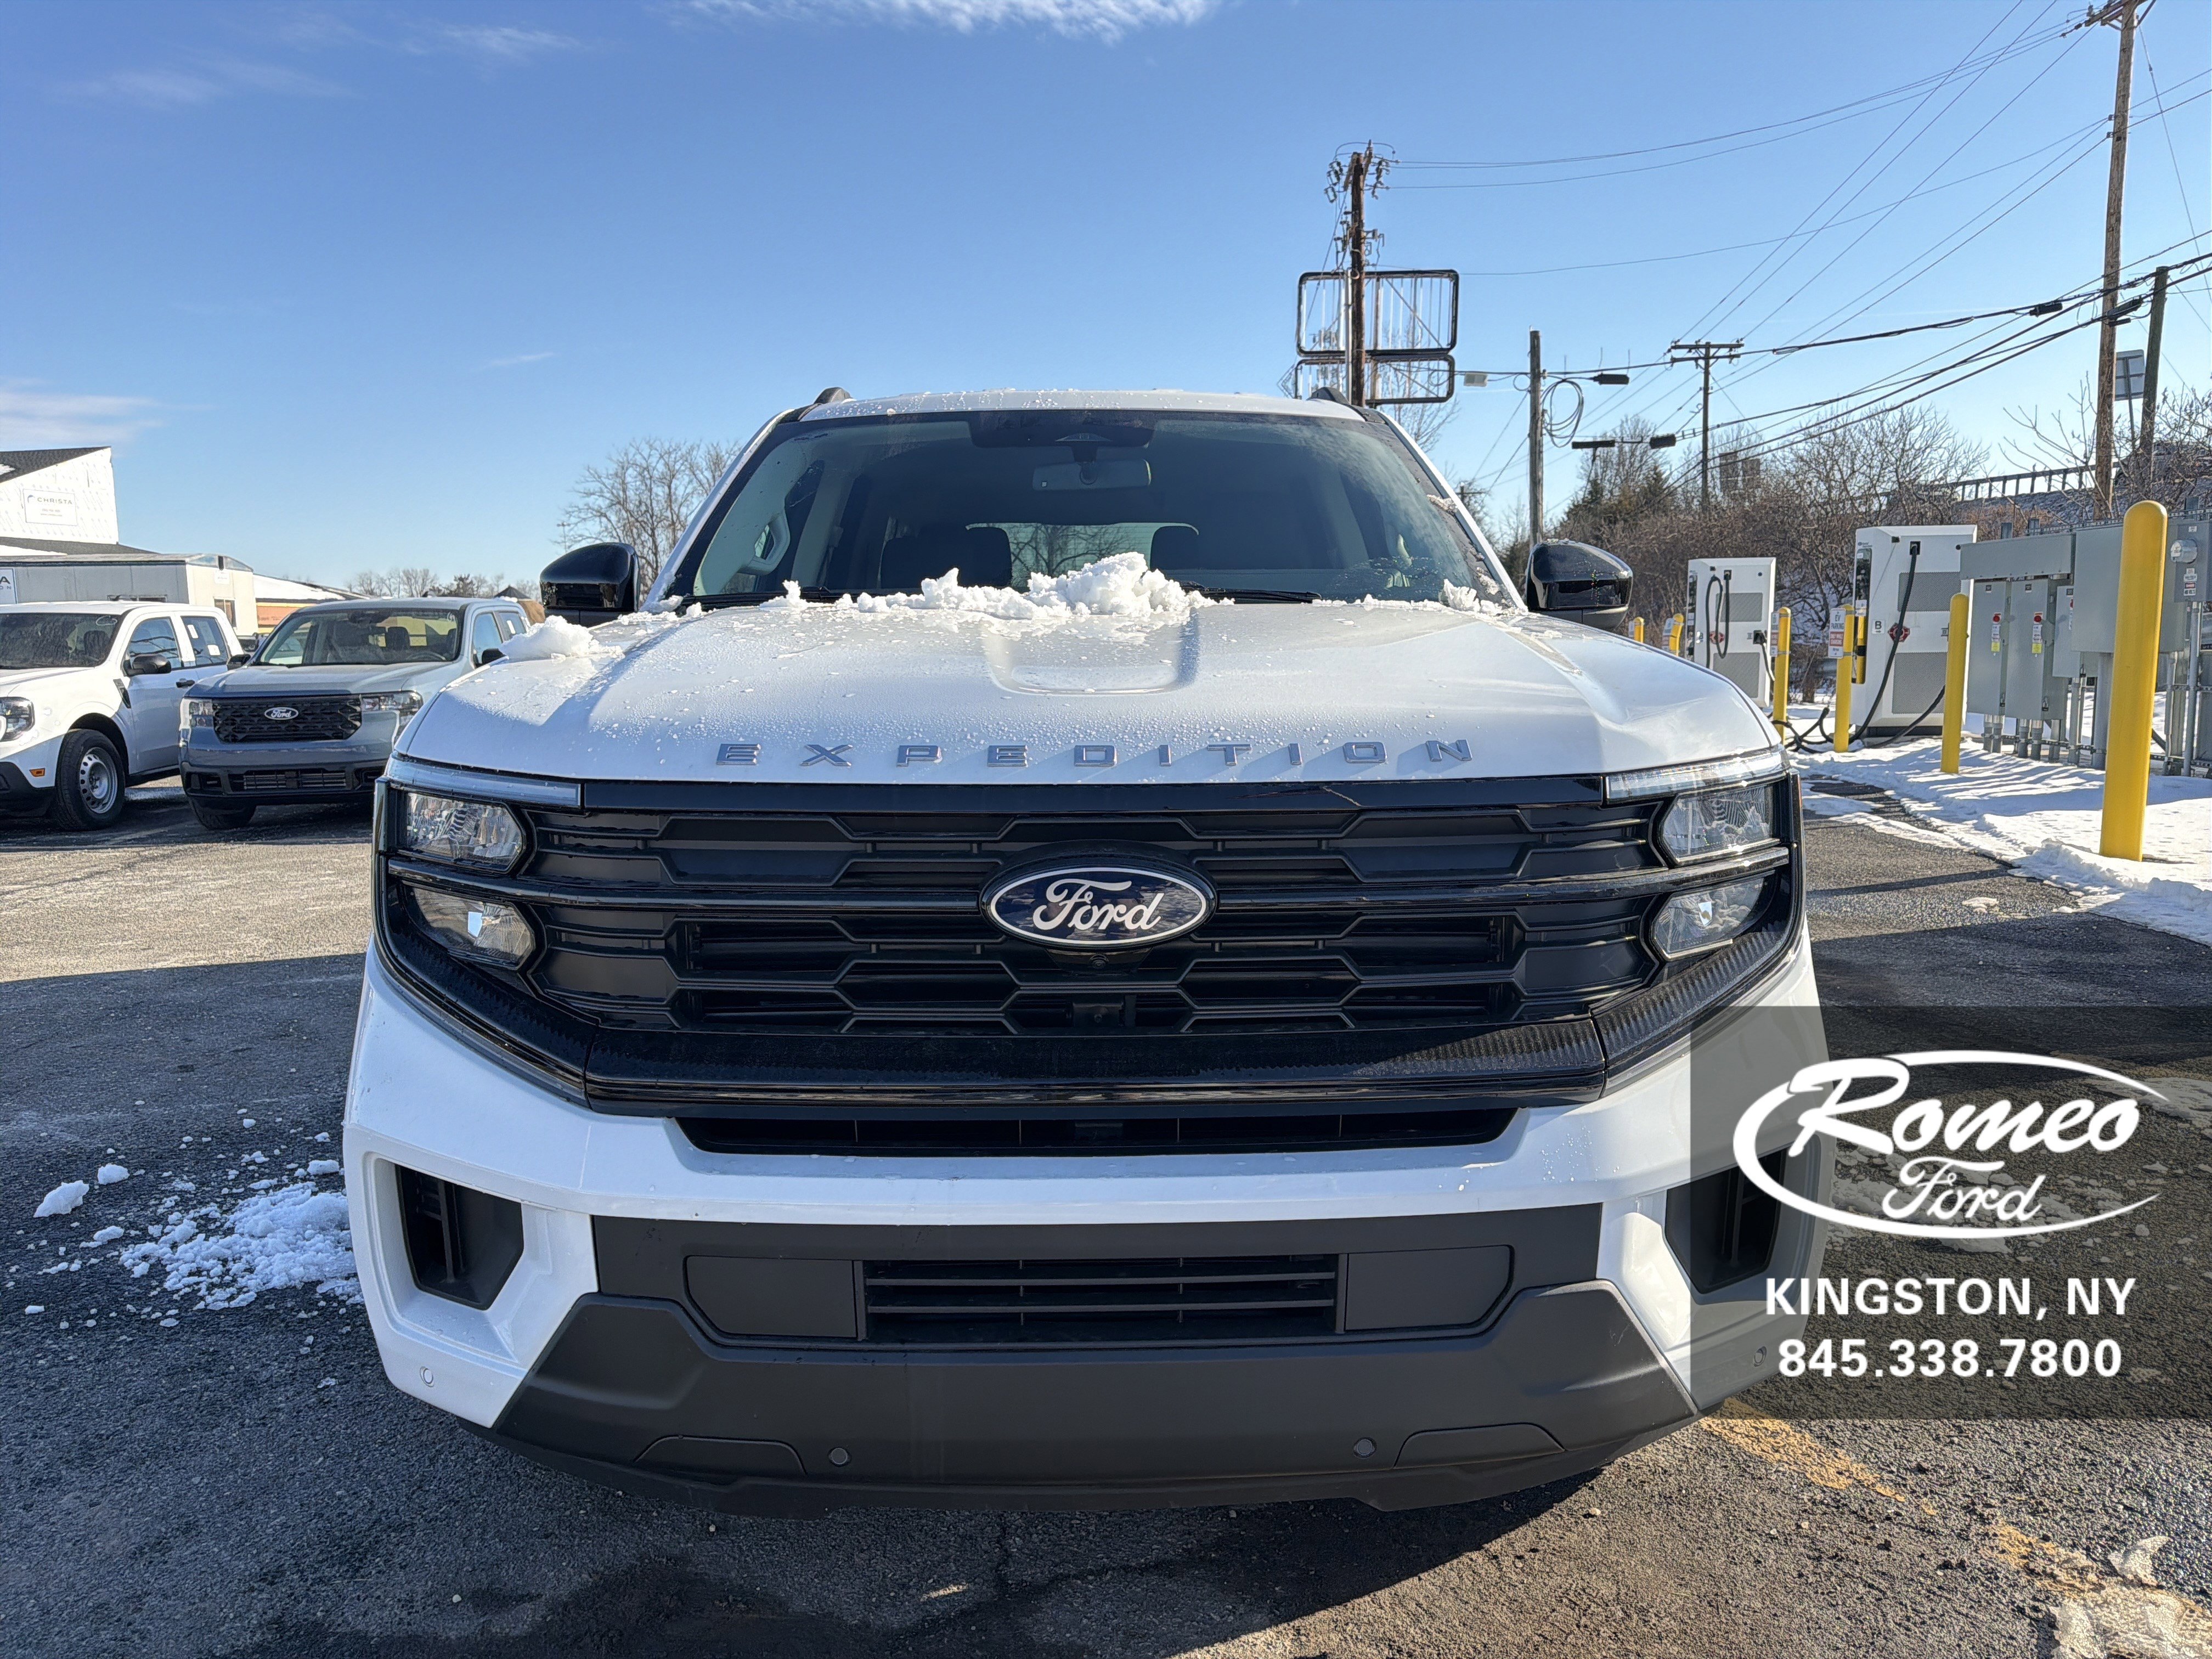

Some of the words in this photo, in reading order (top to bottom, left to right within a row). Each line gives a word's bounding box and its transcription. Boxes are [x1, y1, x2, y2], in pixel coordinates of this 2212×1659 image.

[1875, 620, 1882, 629] B
[270, 708, 292, 718] Ford
[715, 738, 1473, 767] EXPEDITION
[1032, 878, 1165, 931] Ford
